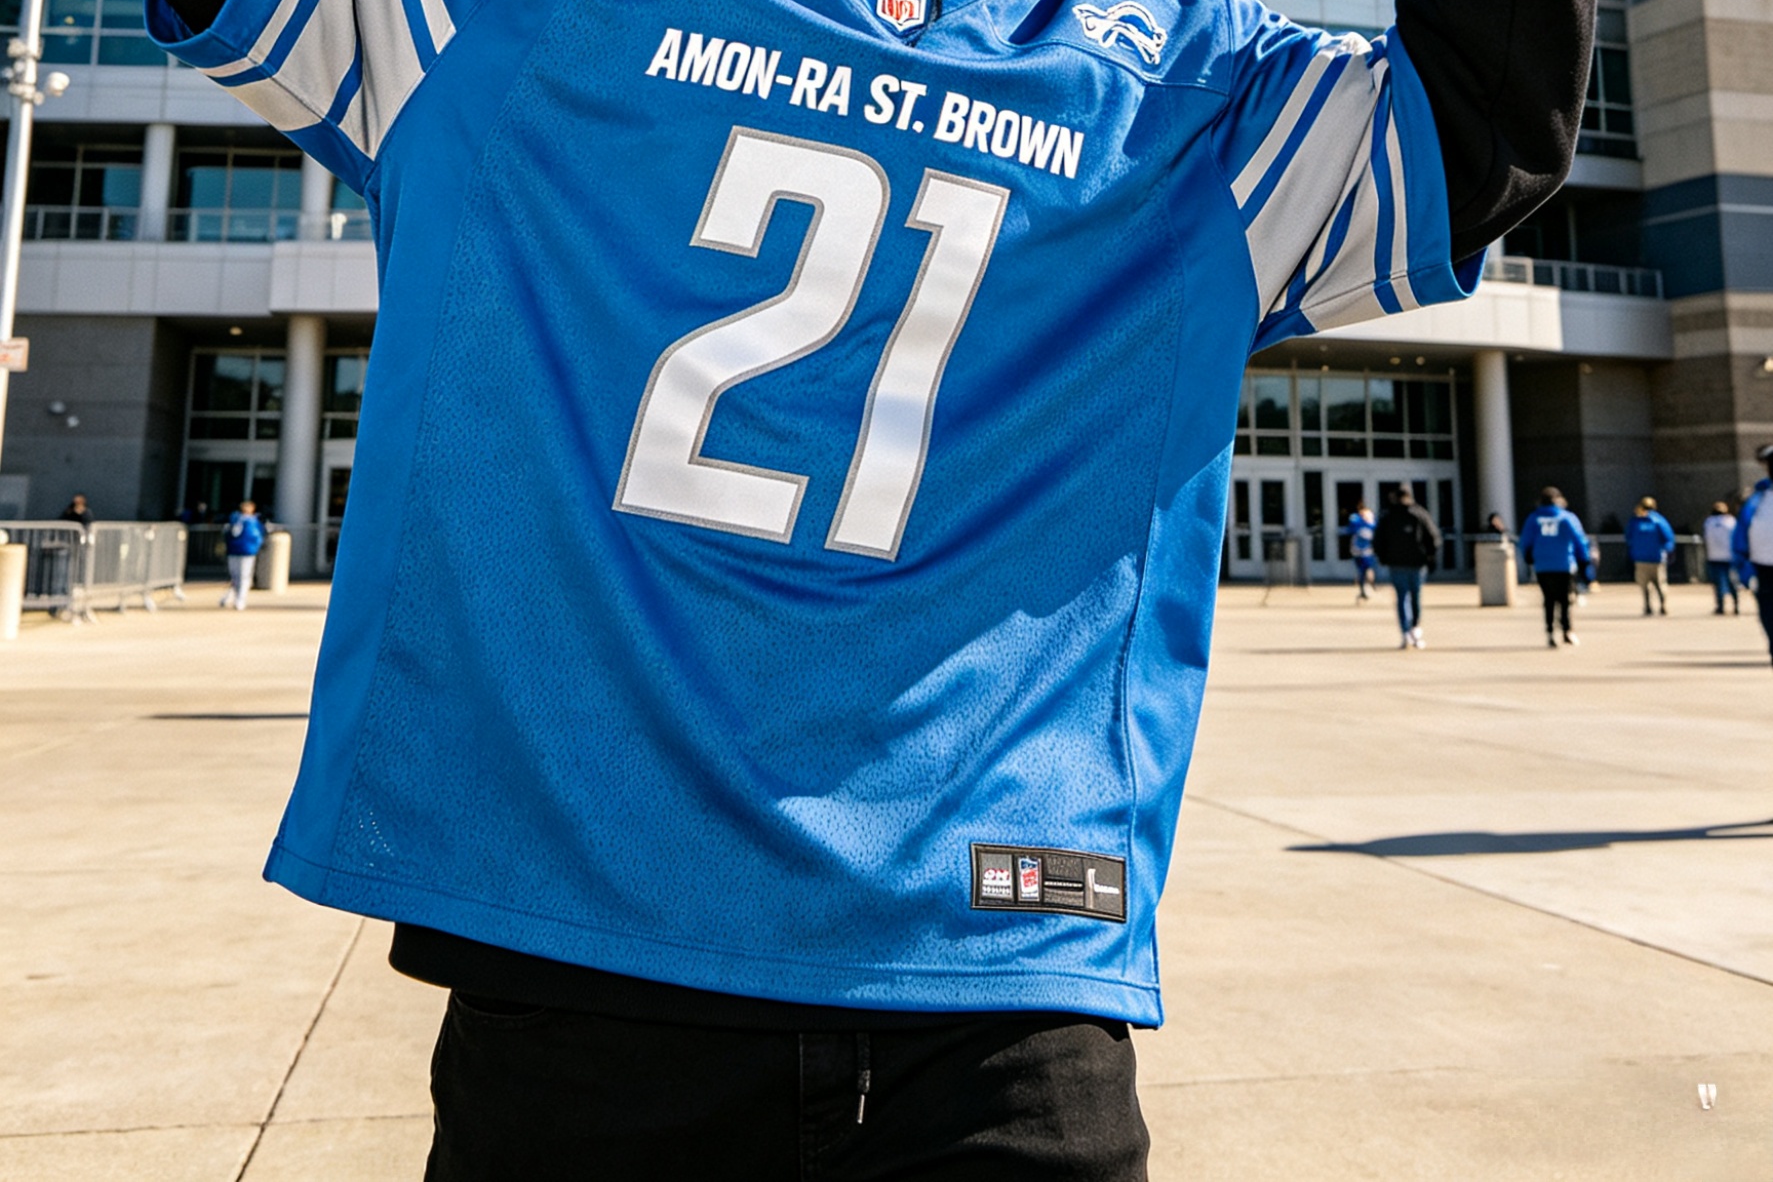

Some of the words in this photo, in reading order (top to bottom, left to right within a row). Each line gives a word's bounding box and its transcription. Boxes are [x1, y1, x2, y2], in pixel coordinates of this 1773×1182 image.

[645, 27, 852, 116] AMON-RA
[863, 74, 928, 133] ST.
[933, 91, 1084, 179] BROWN
[611, 125, 1011, 562] 21
